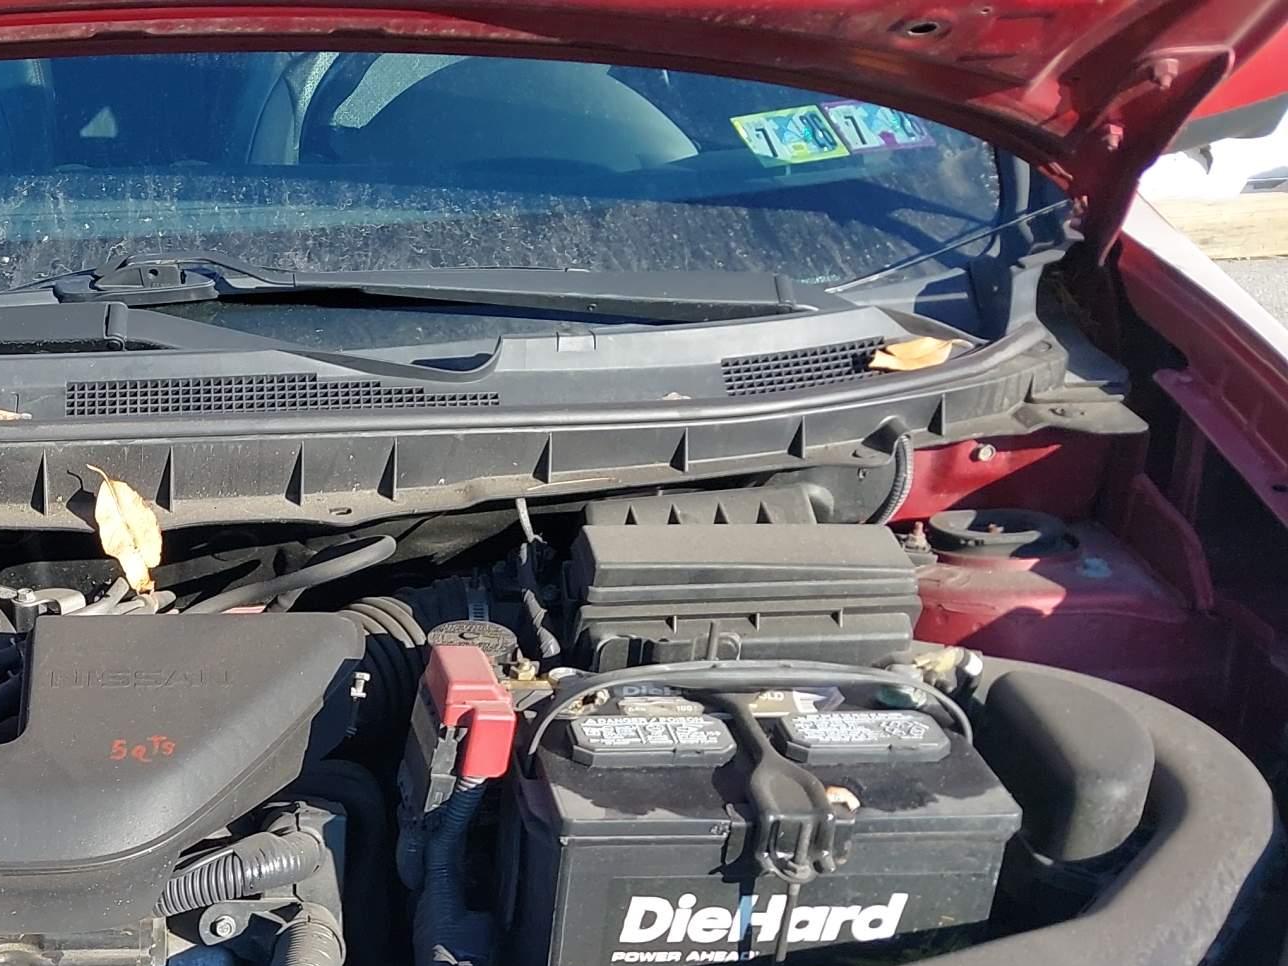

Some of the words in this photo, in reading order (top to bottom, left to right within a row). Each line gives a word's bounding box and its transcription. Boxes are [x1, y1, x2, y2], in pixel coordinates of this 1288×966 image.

[755, 127, 779, 158] 7
[844, 115, 867, 145] 7
[619, 892, 909, 943] DieHard
[611, 951, 682, 962] POWER
